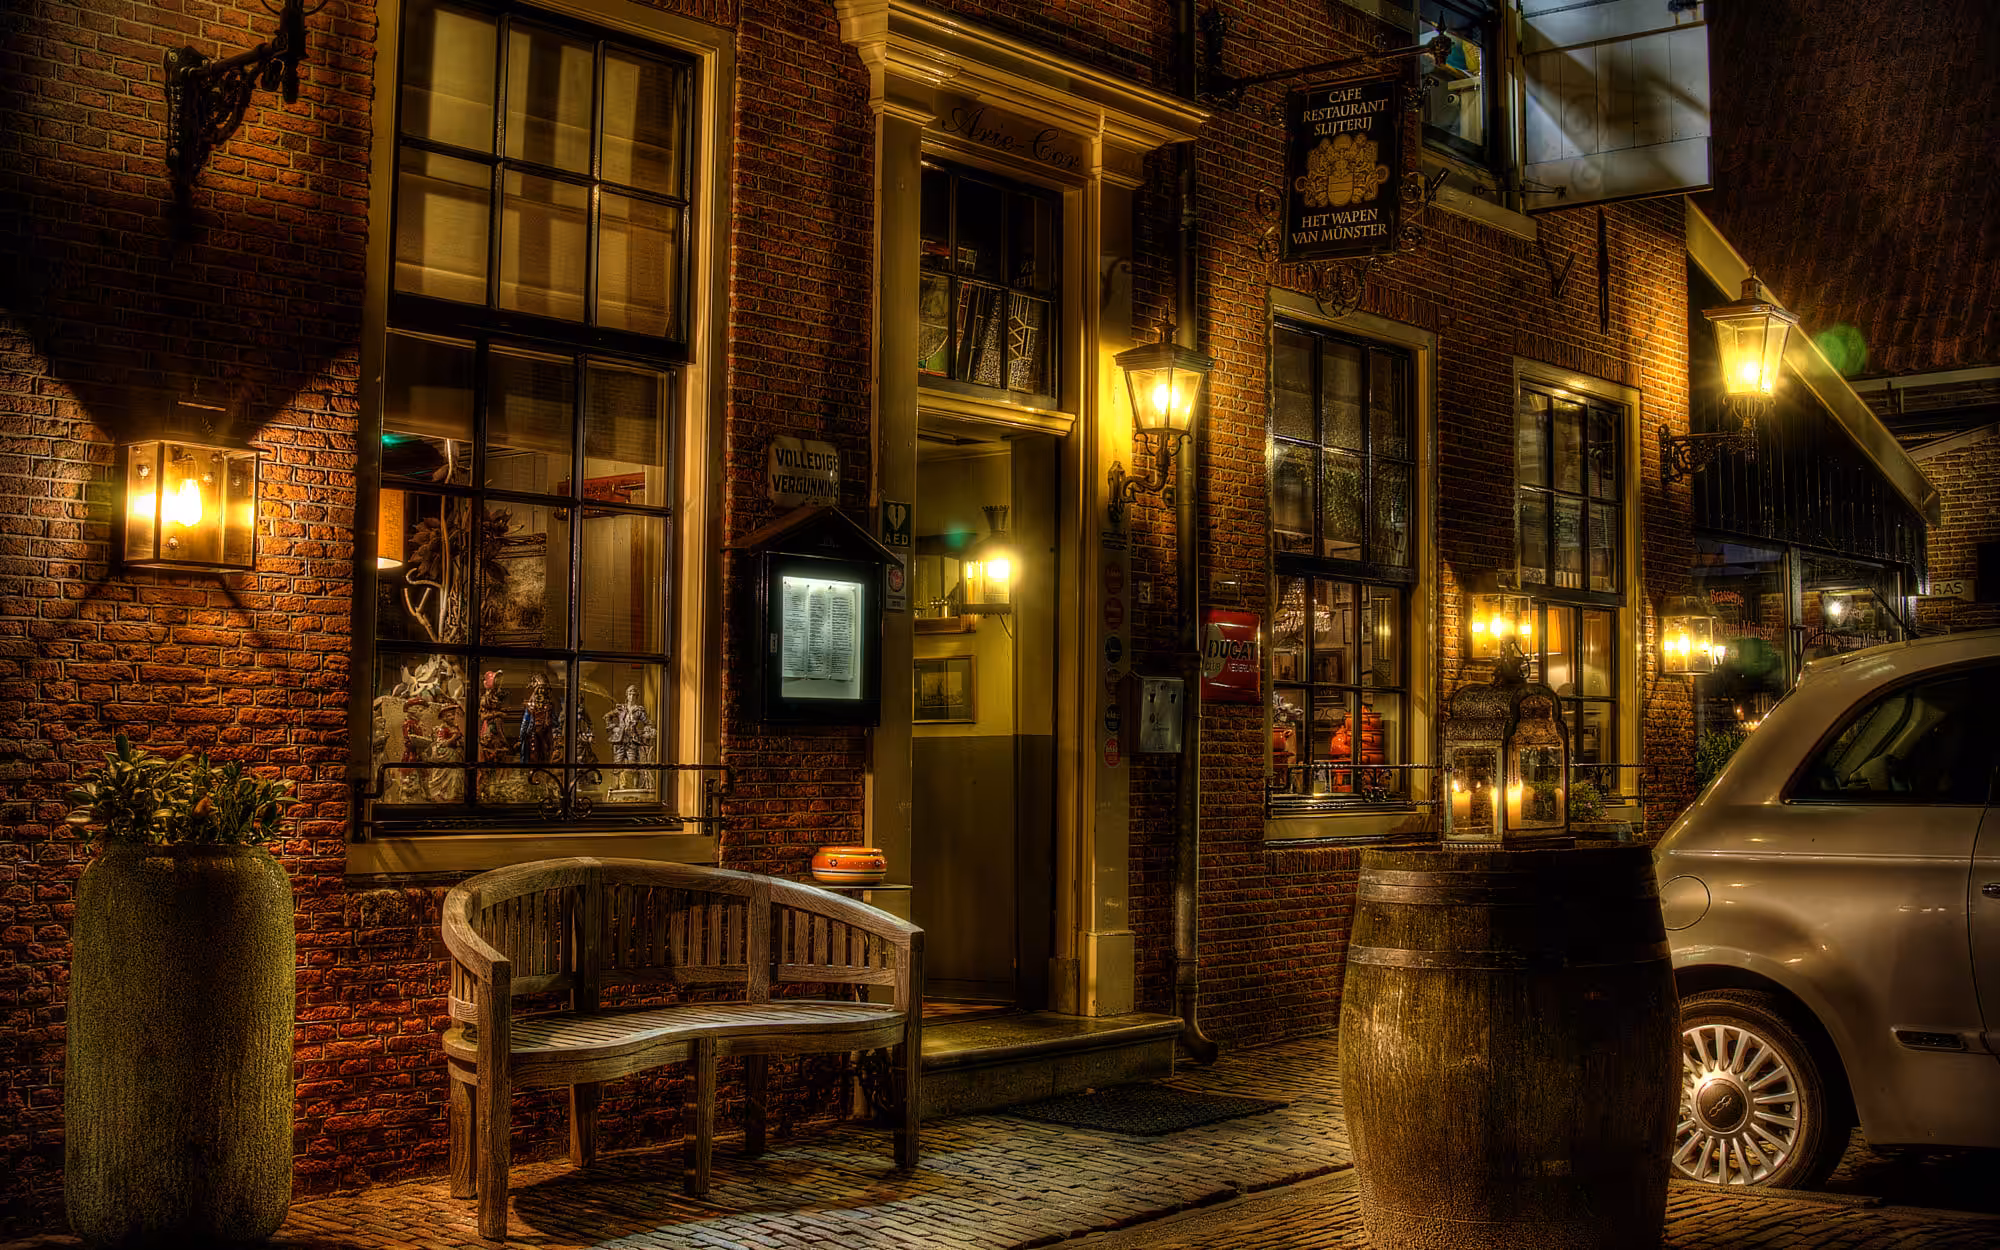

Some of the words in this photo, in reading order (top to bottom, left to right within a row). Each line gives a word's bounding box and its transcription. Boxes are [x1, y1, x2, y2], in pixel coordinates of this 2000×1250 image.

[1328, 88, 1362, 103] CAFE
[1303, 98, 1388, 123] RESTAURANT
[1313, 116, 1373, 137] SLIJTERIJ
[1301, 213, 1330, 228] HET
[1331, 208, 1378, 225] WAPEN
[1291, 231, 1318, 245] VAN
[1321, 223, 1388, 240] MÜNSTER
[775, 448, 840, 473] VOLLEDIGE
[772, 474, 838, 498] VERGUNNING
[884, 533, 908, 546] AED
[1710, 588, 1744, 608] Brasserie
